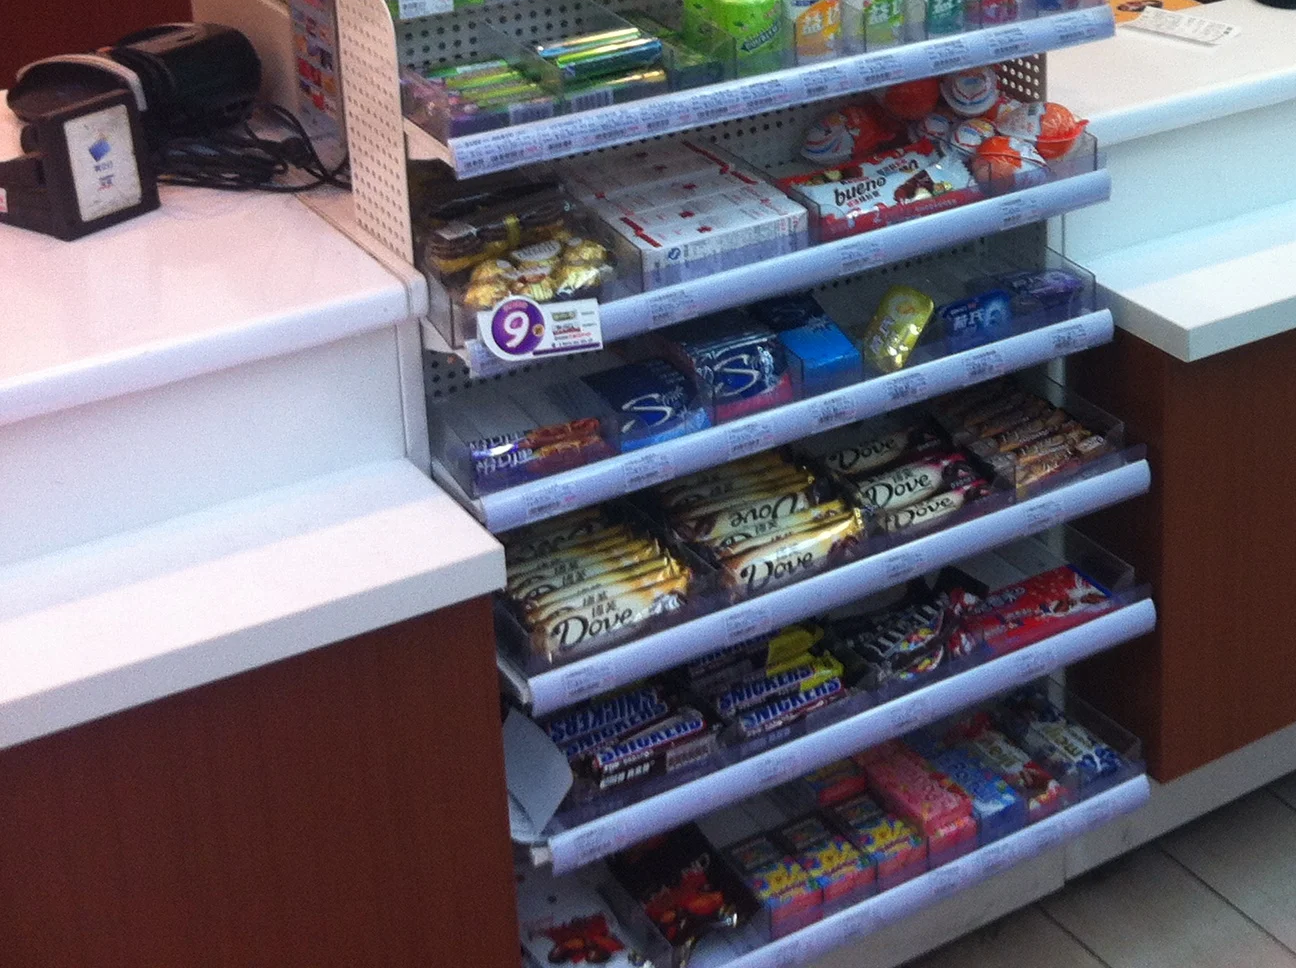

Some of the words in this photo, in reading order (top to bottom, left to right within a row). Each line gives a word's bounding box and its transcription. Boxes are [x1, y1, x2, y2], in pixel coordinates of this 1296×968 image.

[834, 175, 887, 208] bueno
[503, 311, 530, 348] 9
[828, 434, 896, 472] Dove
[865, 474, 932, 509] Dove
[887, 494, 955, 531] Dove
[740, 552, 813, 594] Dove
[551, 607, 633, 646] Dove
[742, 677, 842, 730] SNICKERS
[600, 717, 705, 763] SNICKERS
